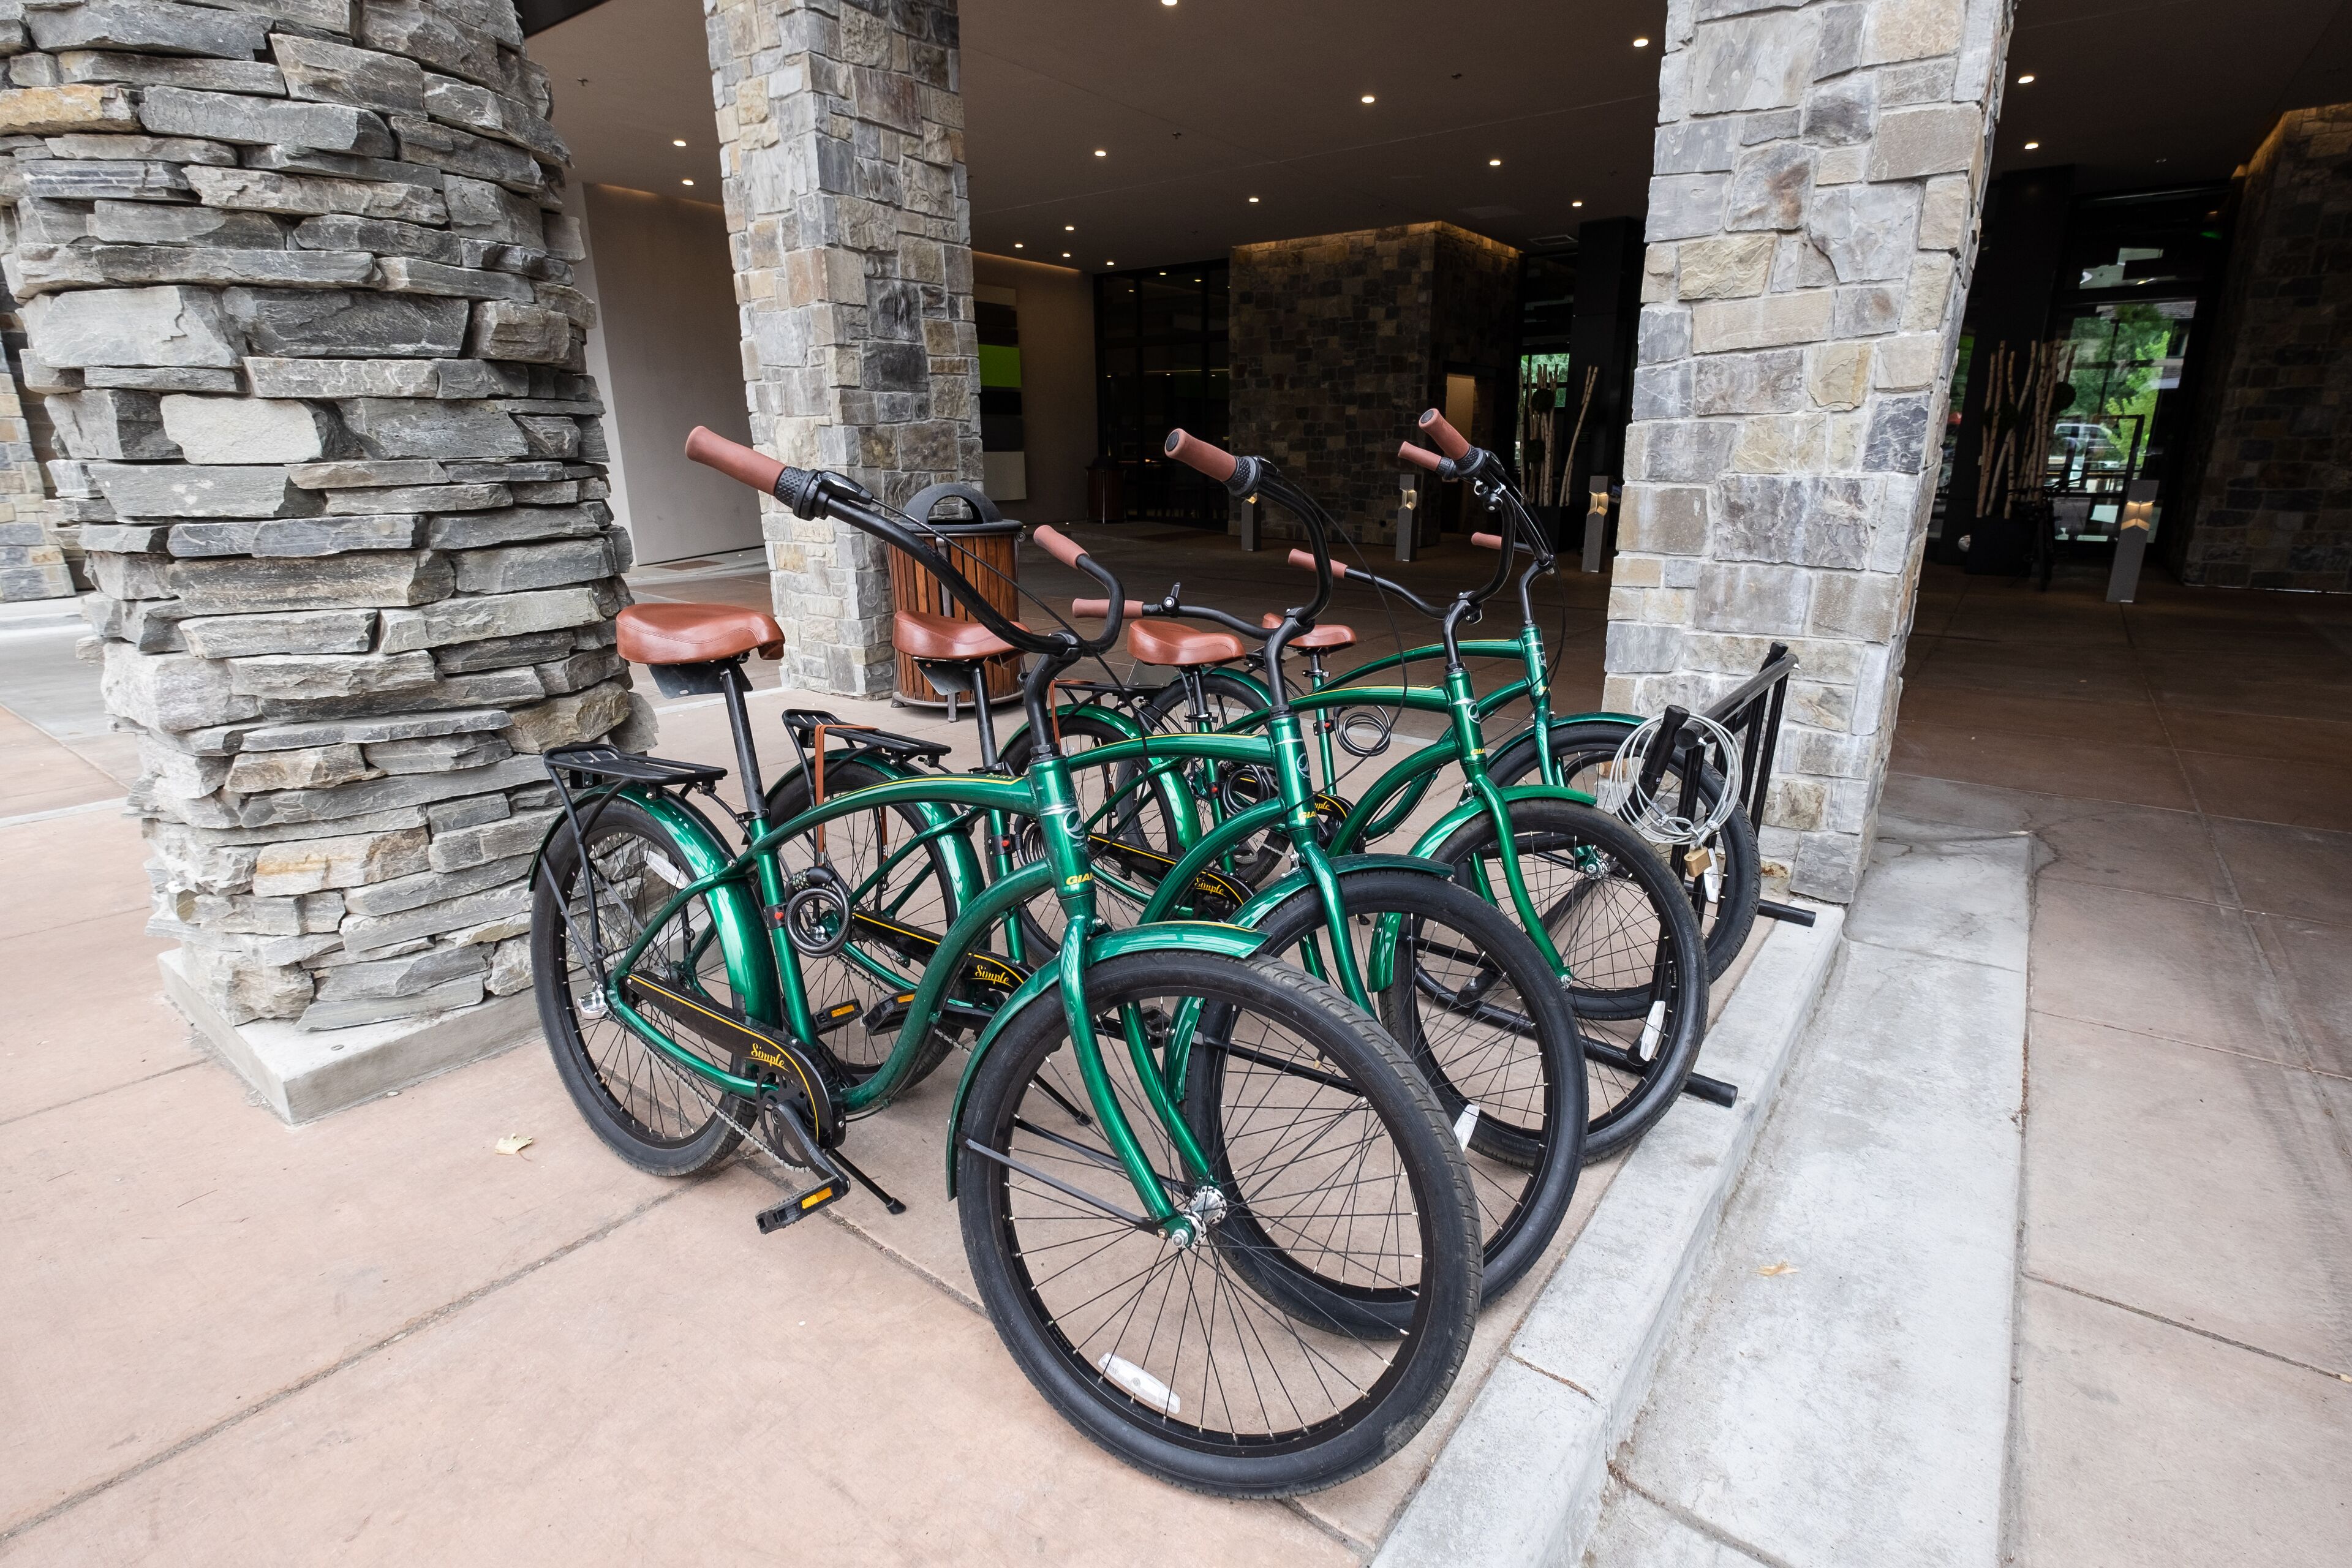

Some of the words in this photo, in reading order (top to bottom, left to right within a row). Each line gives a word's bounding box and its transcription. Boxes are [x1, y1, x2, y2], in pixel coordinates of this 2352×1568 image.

[1194, 877, 1225, 894] Simple
[975, 964, 1010, 985] Simple
[750, 1042, 785, 1067] Simple
